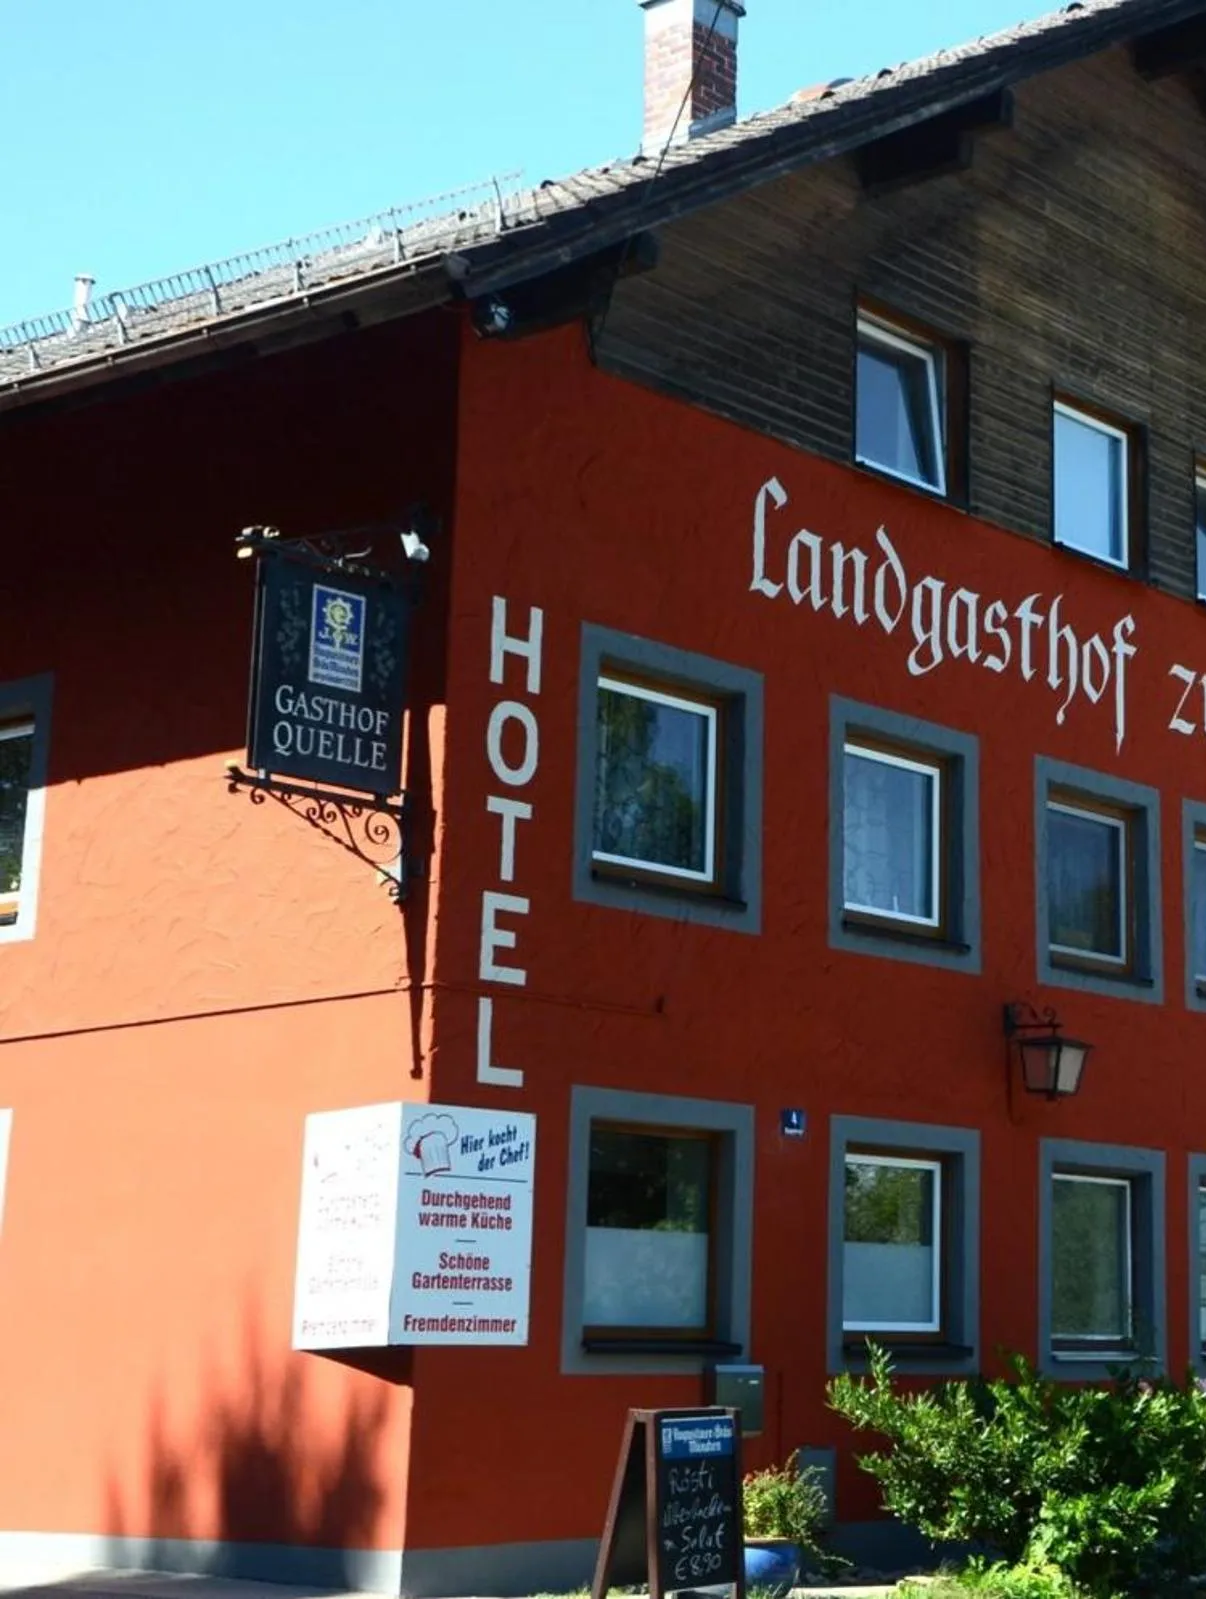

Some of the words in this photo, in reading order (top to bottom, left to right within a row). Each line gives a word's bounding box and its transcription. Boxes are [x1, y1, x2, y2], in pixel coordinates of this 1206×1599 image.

[749, 476, 1137, 756] Landgasthof
[274, 684, 390, 737] GASTHOF
[273, 721, 388, 771] QUELLE
[476, 595, 544, 1088] HOTEL
[459, 1138, 484, 1155] Hier
[488, 1124, 518, 1147] kocht
[477, 1153, 496, 1173] der
[499, 1142, 530, 1167] Chef!
[421, 1189, 512, 1211] Durchgehend
[418, 1211, 467, 1229] warme
[471, 1211, 513, 1231] Küche
[438, 1251, 491, 1271] Schöne
[411, 1271, 514, 1292] Gartenterrasse
[403, 1314, 518, 1334] Fremdenzimmer
